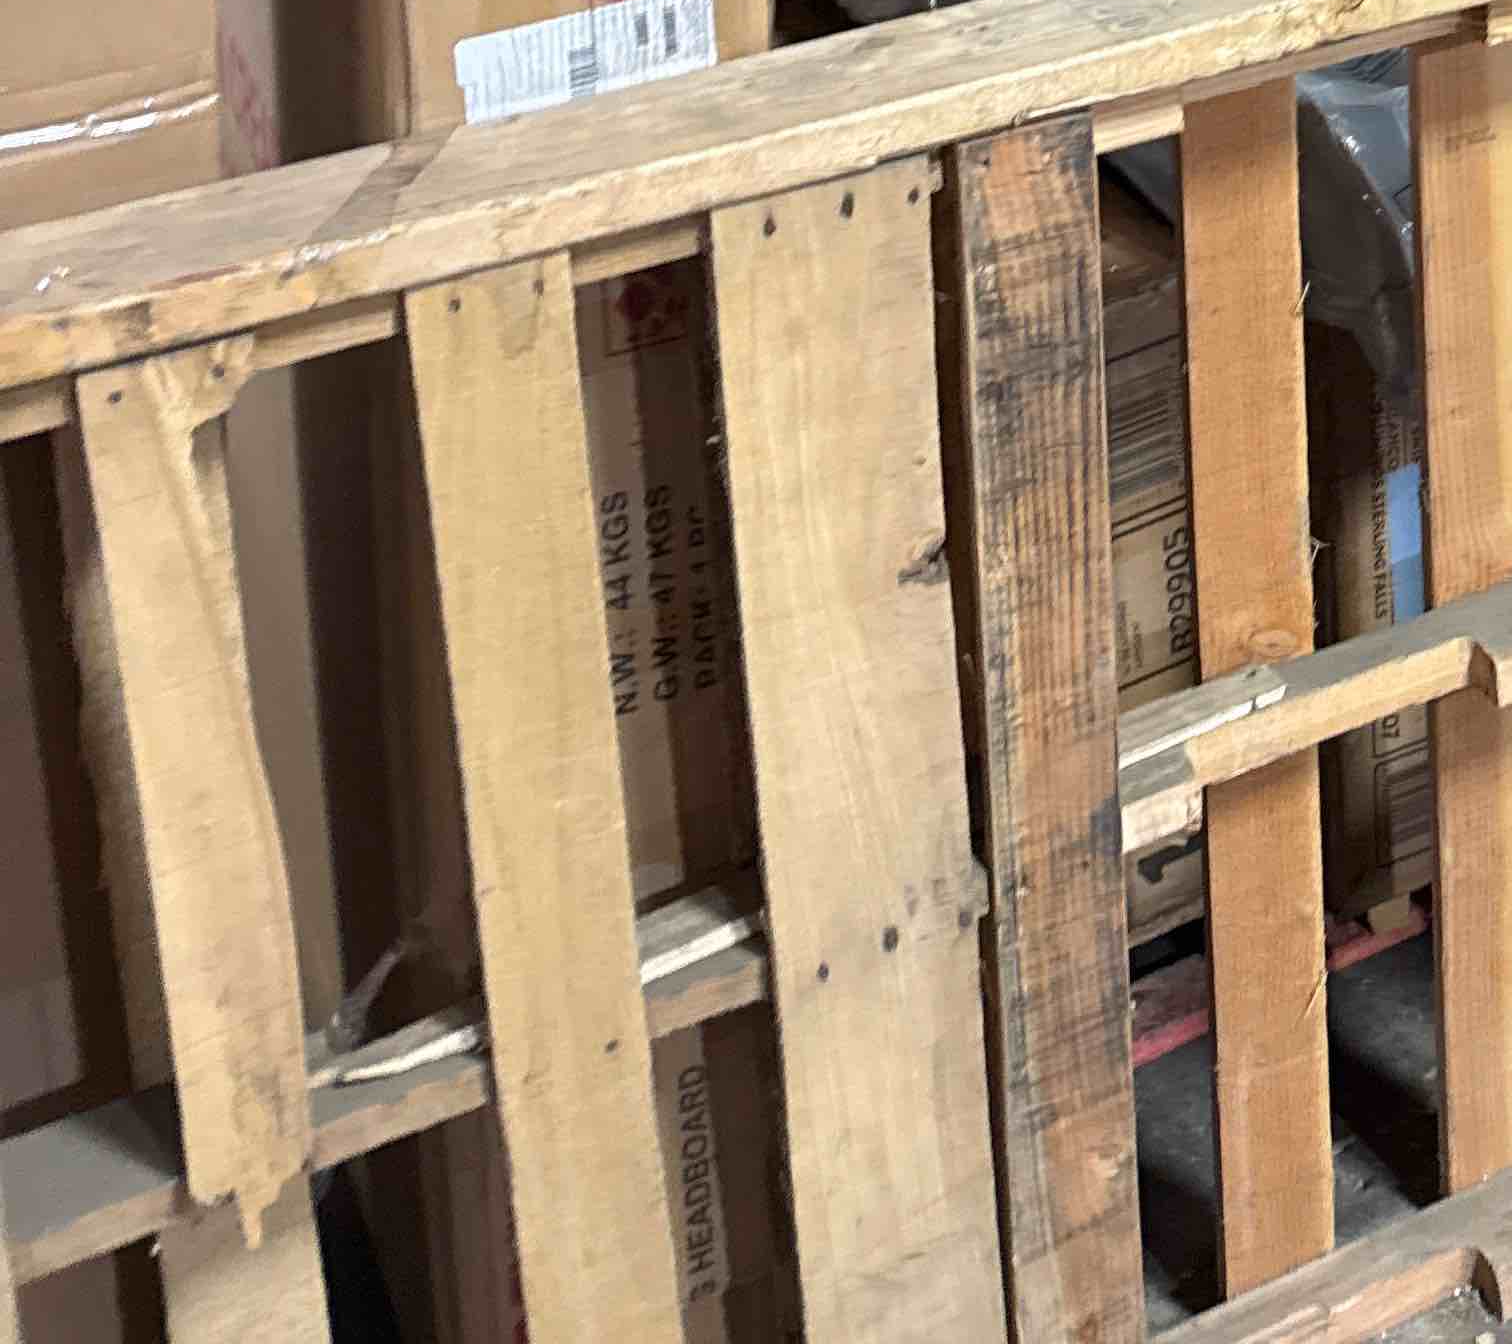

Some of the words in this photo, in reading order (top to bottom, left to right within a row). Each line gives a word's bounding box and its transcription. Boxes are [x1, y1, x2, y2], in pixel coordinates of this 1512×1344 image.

[600, 490, 631, 567] KGS
[645, 484, 675, 561] KGS
[1373, 571, 1389, 620] FALLS
[676, 1065, 716, 1274] HEADBOARD
